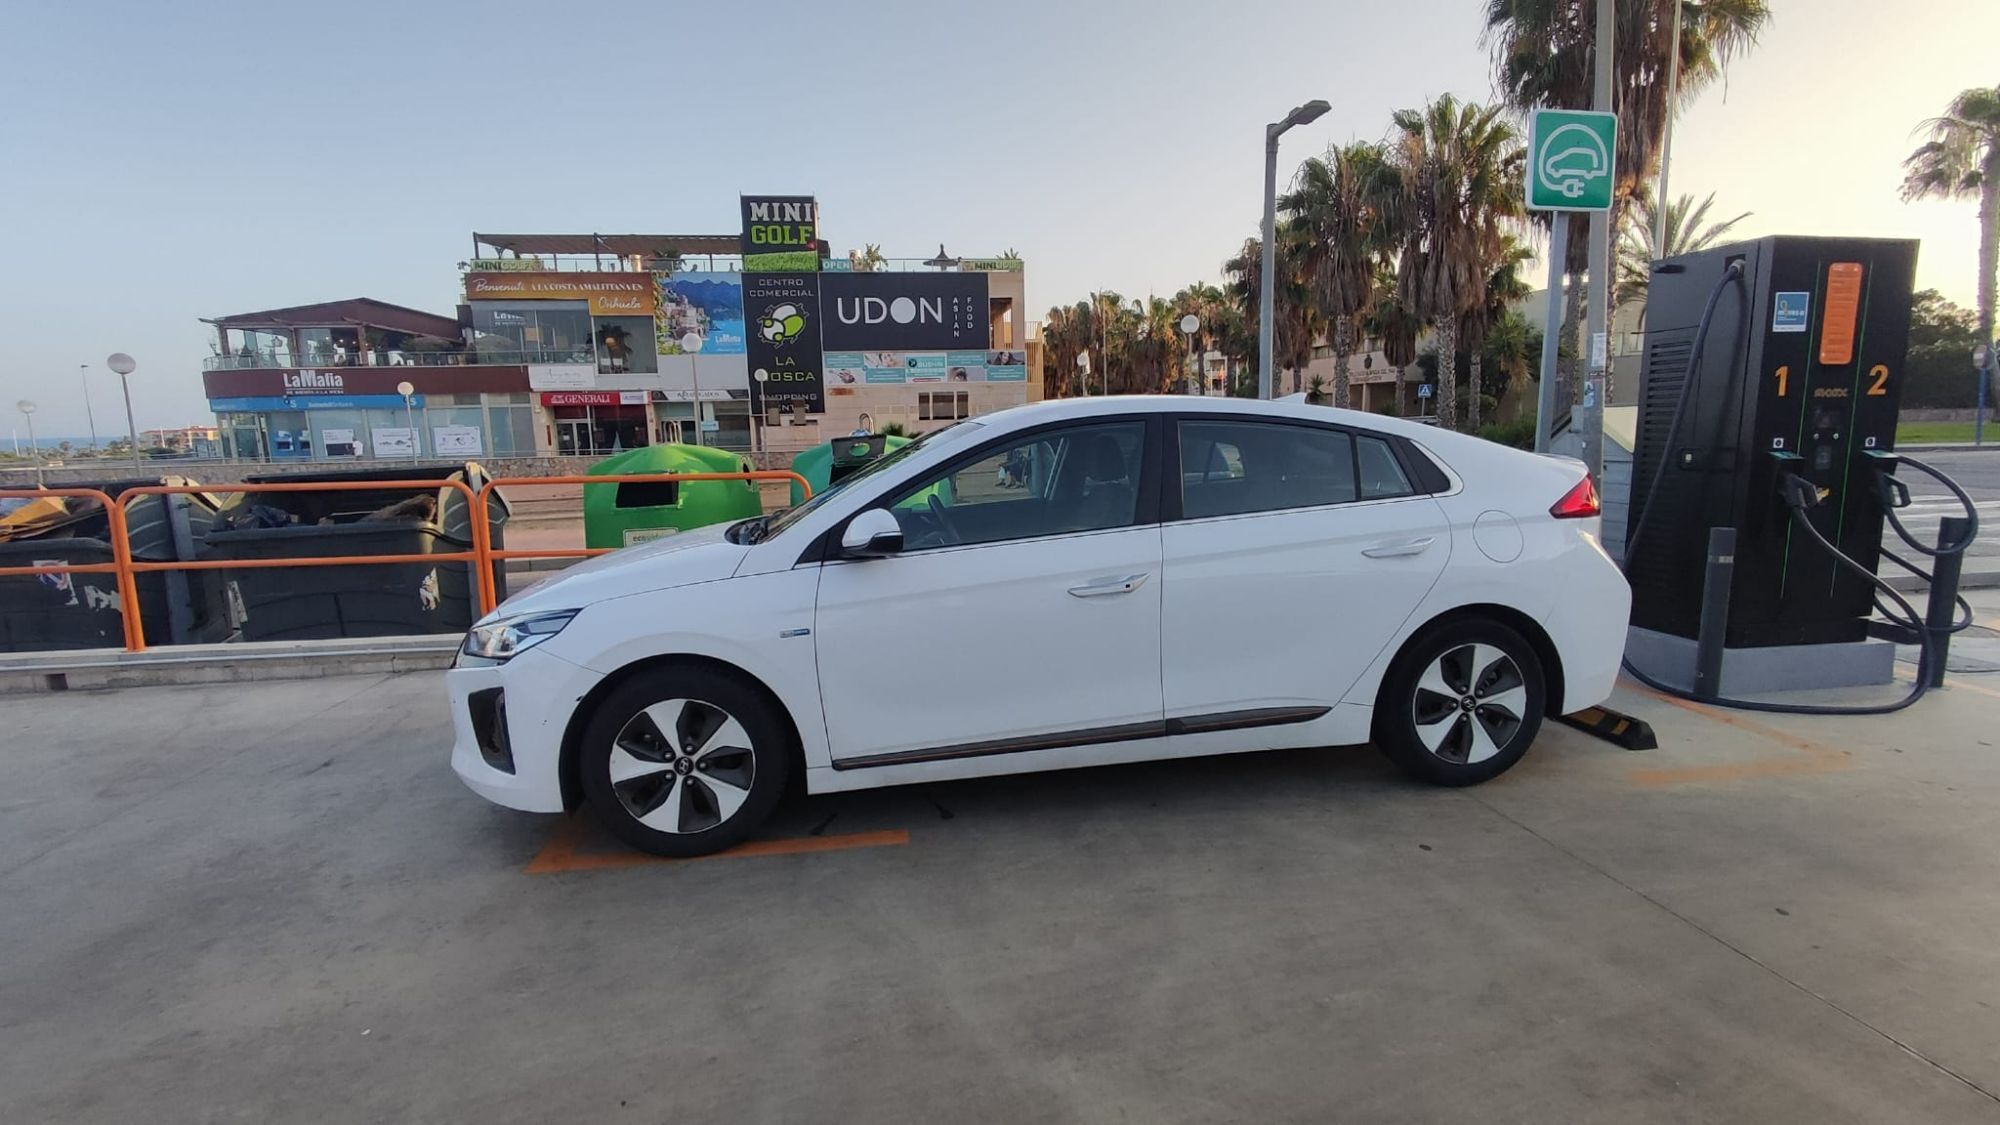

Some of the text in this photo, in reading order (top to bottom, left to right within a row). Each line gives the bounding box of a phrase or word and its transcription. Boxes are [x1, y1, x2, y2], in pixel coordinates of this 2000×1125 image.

[750, 203, 813, 221] MINI
[751, 225, 814, 244] GOLF
[823, 259, 850, 270] OPEN
[837, 297, 943, 325] UDON
[775, 356, 796, 366] LA
[762, 372, 816, 382] OSCA
[1775, 366, 1788, 396] 1
[1867, 364, 1888, 395] 2
[564, 394, 612, 404] GENERALI
